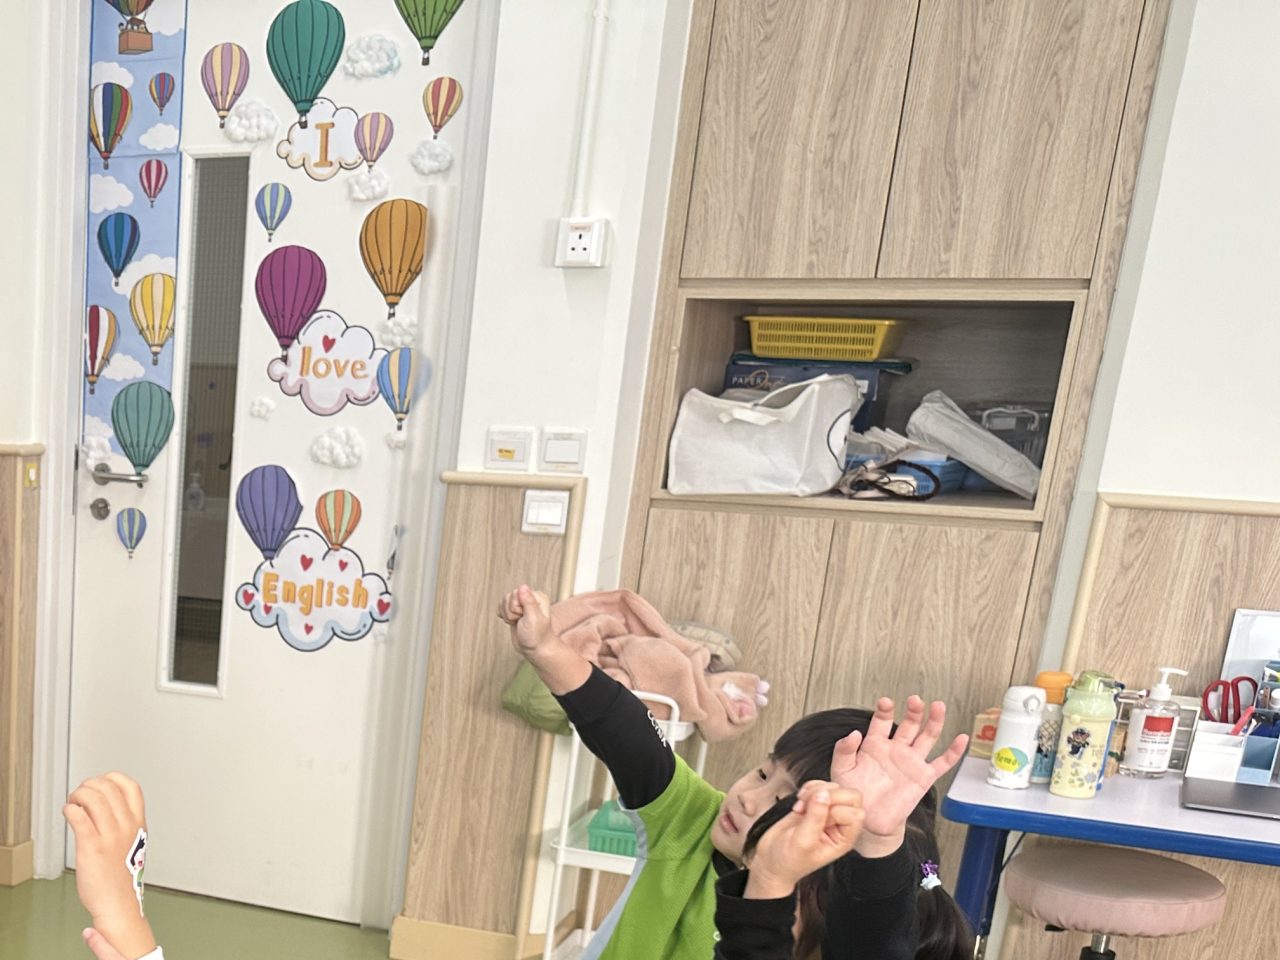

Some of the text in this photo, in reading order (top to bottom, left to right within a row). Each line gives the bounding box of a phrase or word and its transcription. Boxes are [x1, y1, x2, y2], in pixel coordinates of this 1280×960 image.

[313, 121, 335, 168] I
[299, 346, 369, 380] love
[262, 571, 369, 616] English
